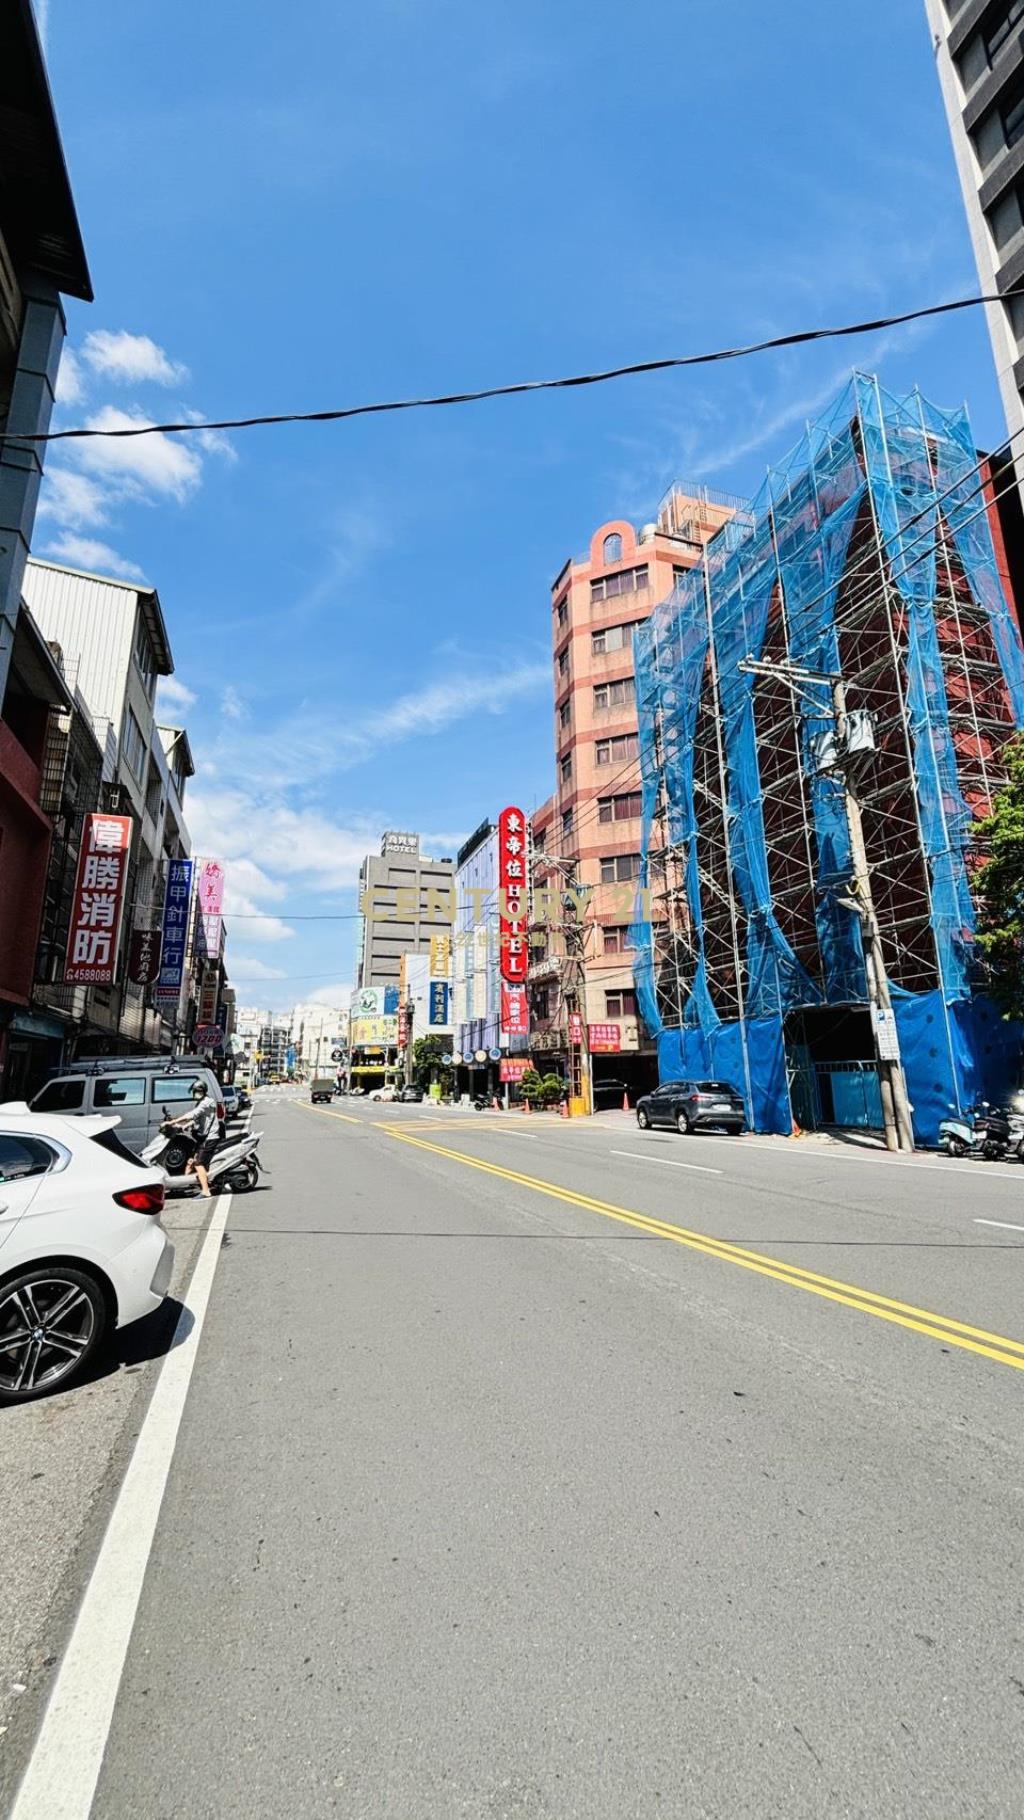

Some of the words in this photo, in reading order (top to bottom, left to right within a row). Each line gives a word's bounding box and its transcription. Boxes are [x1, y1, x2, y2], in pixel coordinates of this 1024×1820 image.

[505, 812, 525, 878] 東帝位
[72, 819, 125, 965] 偉勝消防
[163, 864, 190, 965] 振甲針車行
[506, 884, 524, 973] HOTEL
[74, 969, 112, 982] 4588088
